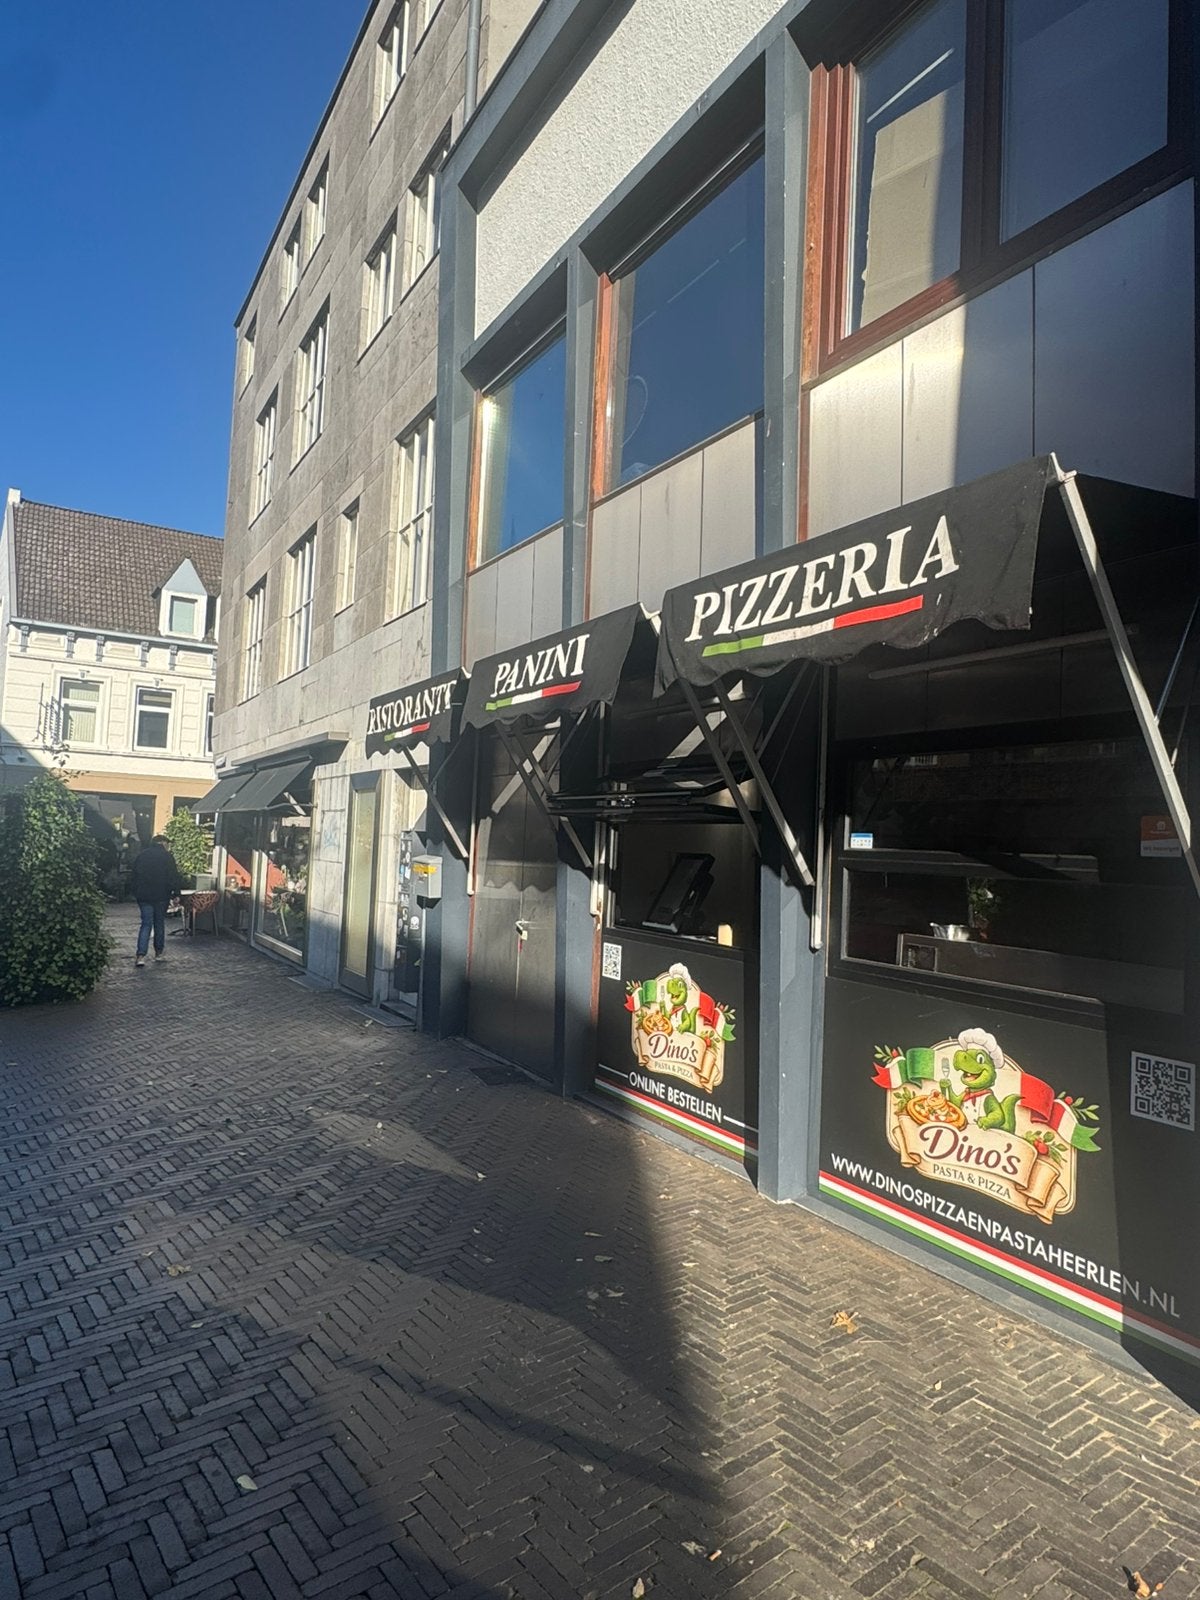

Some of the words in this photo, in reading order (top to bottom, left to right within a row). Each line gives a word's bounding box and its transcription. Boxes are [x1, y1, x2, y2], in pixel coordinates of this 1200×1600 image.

[684, 514, 959, 642] PIZZERIA
[490, 633, 590, 698] PANINI
[649, 1033, 698, 1063] Dino's
[654, 1061, 671, 1071] PASTA
[677, 1066, 693, 1079] PIZZA
[630, 1071, 665, 1099] ONLINE
[667, 1087, 722, 1123] BESTELLEN
[919, 1125, 1021, 1176] Dino's
[933, 1164, 965, 1182] PASTA
[967, 1173, 976, 1184] &
[978, 1176, 1011, 1200] PIZZA
[831, 1153, 1180, 1318] WWW.DINOSPIZZAENPASTAHEERLEN.NL
